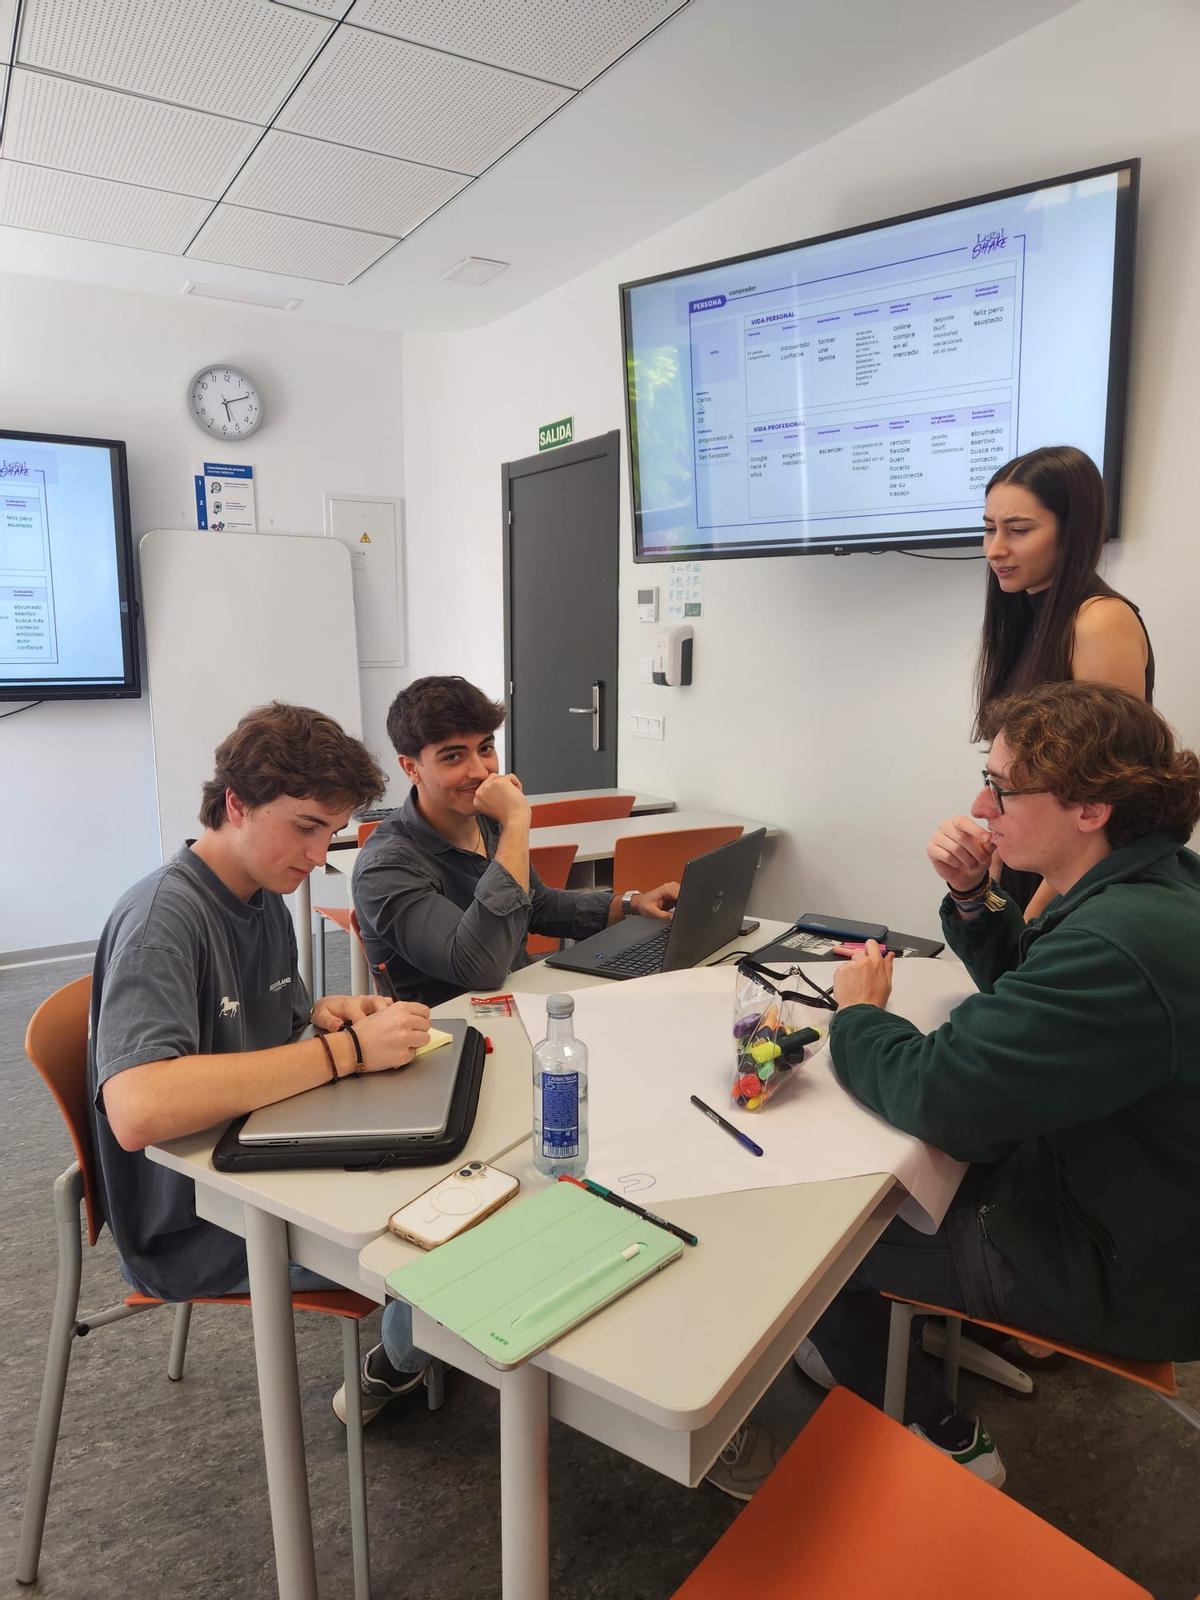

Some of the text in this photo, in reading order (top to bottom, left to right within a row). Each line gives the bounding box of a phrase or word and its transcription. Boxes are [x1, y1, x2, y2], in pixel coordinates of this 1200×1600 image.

[972, 237, 1008, 260] SHAKE
[729, 285, 757, 296] comprador
[693, 298, 722, 310] PERSONA
[988, 306, 1004, 315] pero
[751, 311, 794, 326] VIDA PERSONAL
[973, 316, 1003, 327] asustado
[893, 349, 919, 359] mercado
[753, 420, 806, 433] VIDA PROFESIONAL
[970, 427, 1004, 437] abrumado
[540, 423, 571, 447] SALIDA
[890, 438, 911, 446] remoto
[970, 455, 998, 464] contacto
